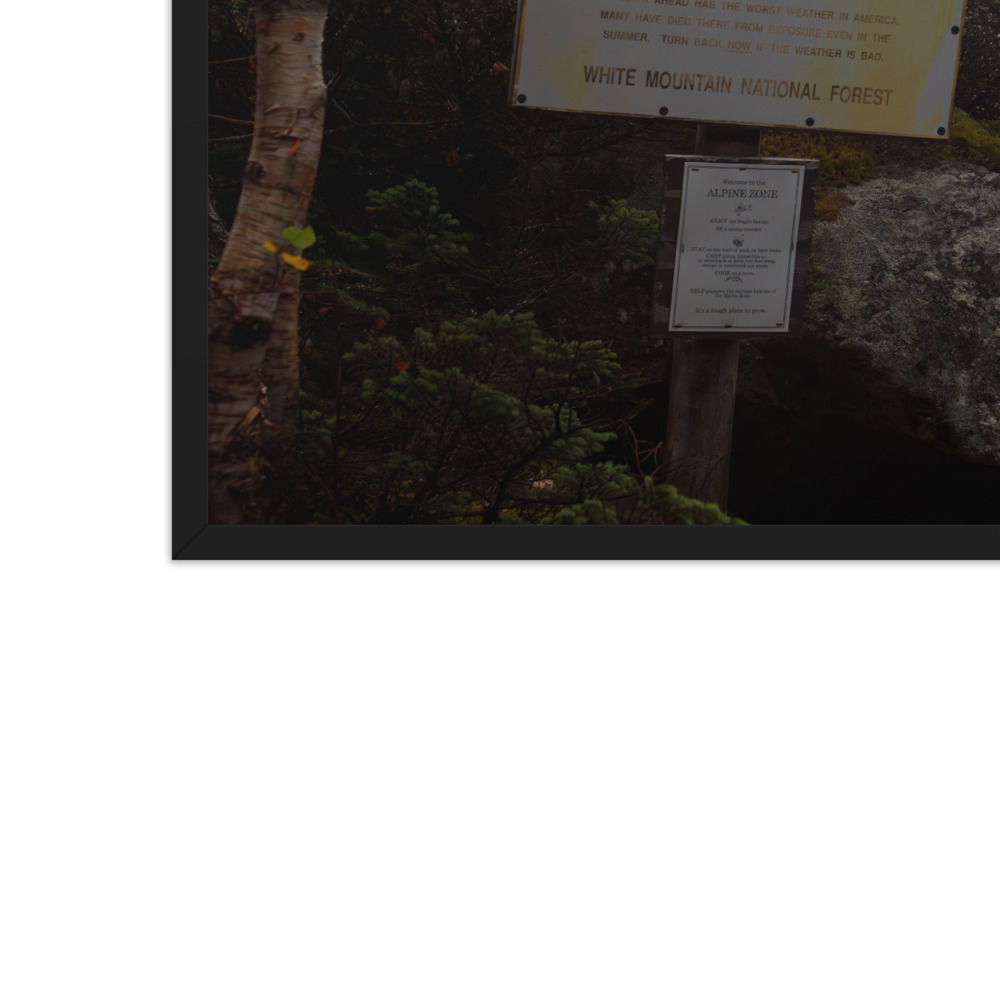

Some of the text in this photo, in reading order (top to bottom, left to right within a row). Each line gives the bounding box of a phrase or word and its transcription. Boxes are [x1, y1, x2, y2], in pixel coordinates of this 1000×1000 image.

[694, 0, 716, 9] HAS
[721, 1, 740, 12] THE
[746, 3, 781, 16] WORST
[786, 7, 834, 20] WEATHER
[839, 11, 849, 21] IN
[600, 10, 892, 43] MANY HAVE DIED THERE FROM EXPOSURE EVEN IN THE
[603, 30, 650, 43] SUMMER.
[661, 34, 688, 46] TURN
[694, 37, 722, 49] BACK
[727, 39, 751, 51] NOW
[756, 42, 765, 52] IF
[770, 42, 791, 54] THE
[795, 46, 842, 58] WEATHER
[846, 50, 856, 60] IS
[583, 65, 894, 106] WHITE MOUNTAIN NATIONAL FOREST
[707, 188, 778, 199] ALPINE ZONE
